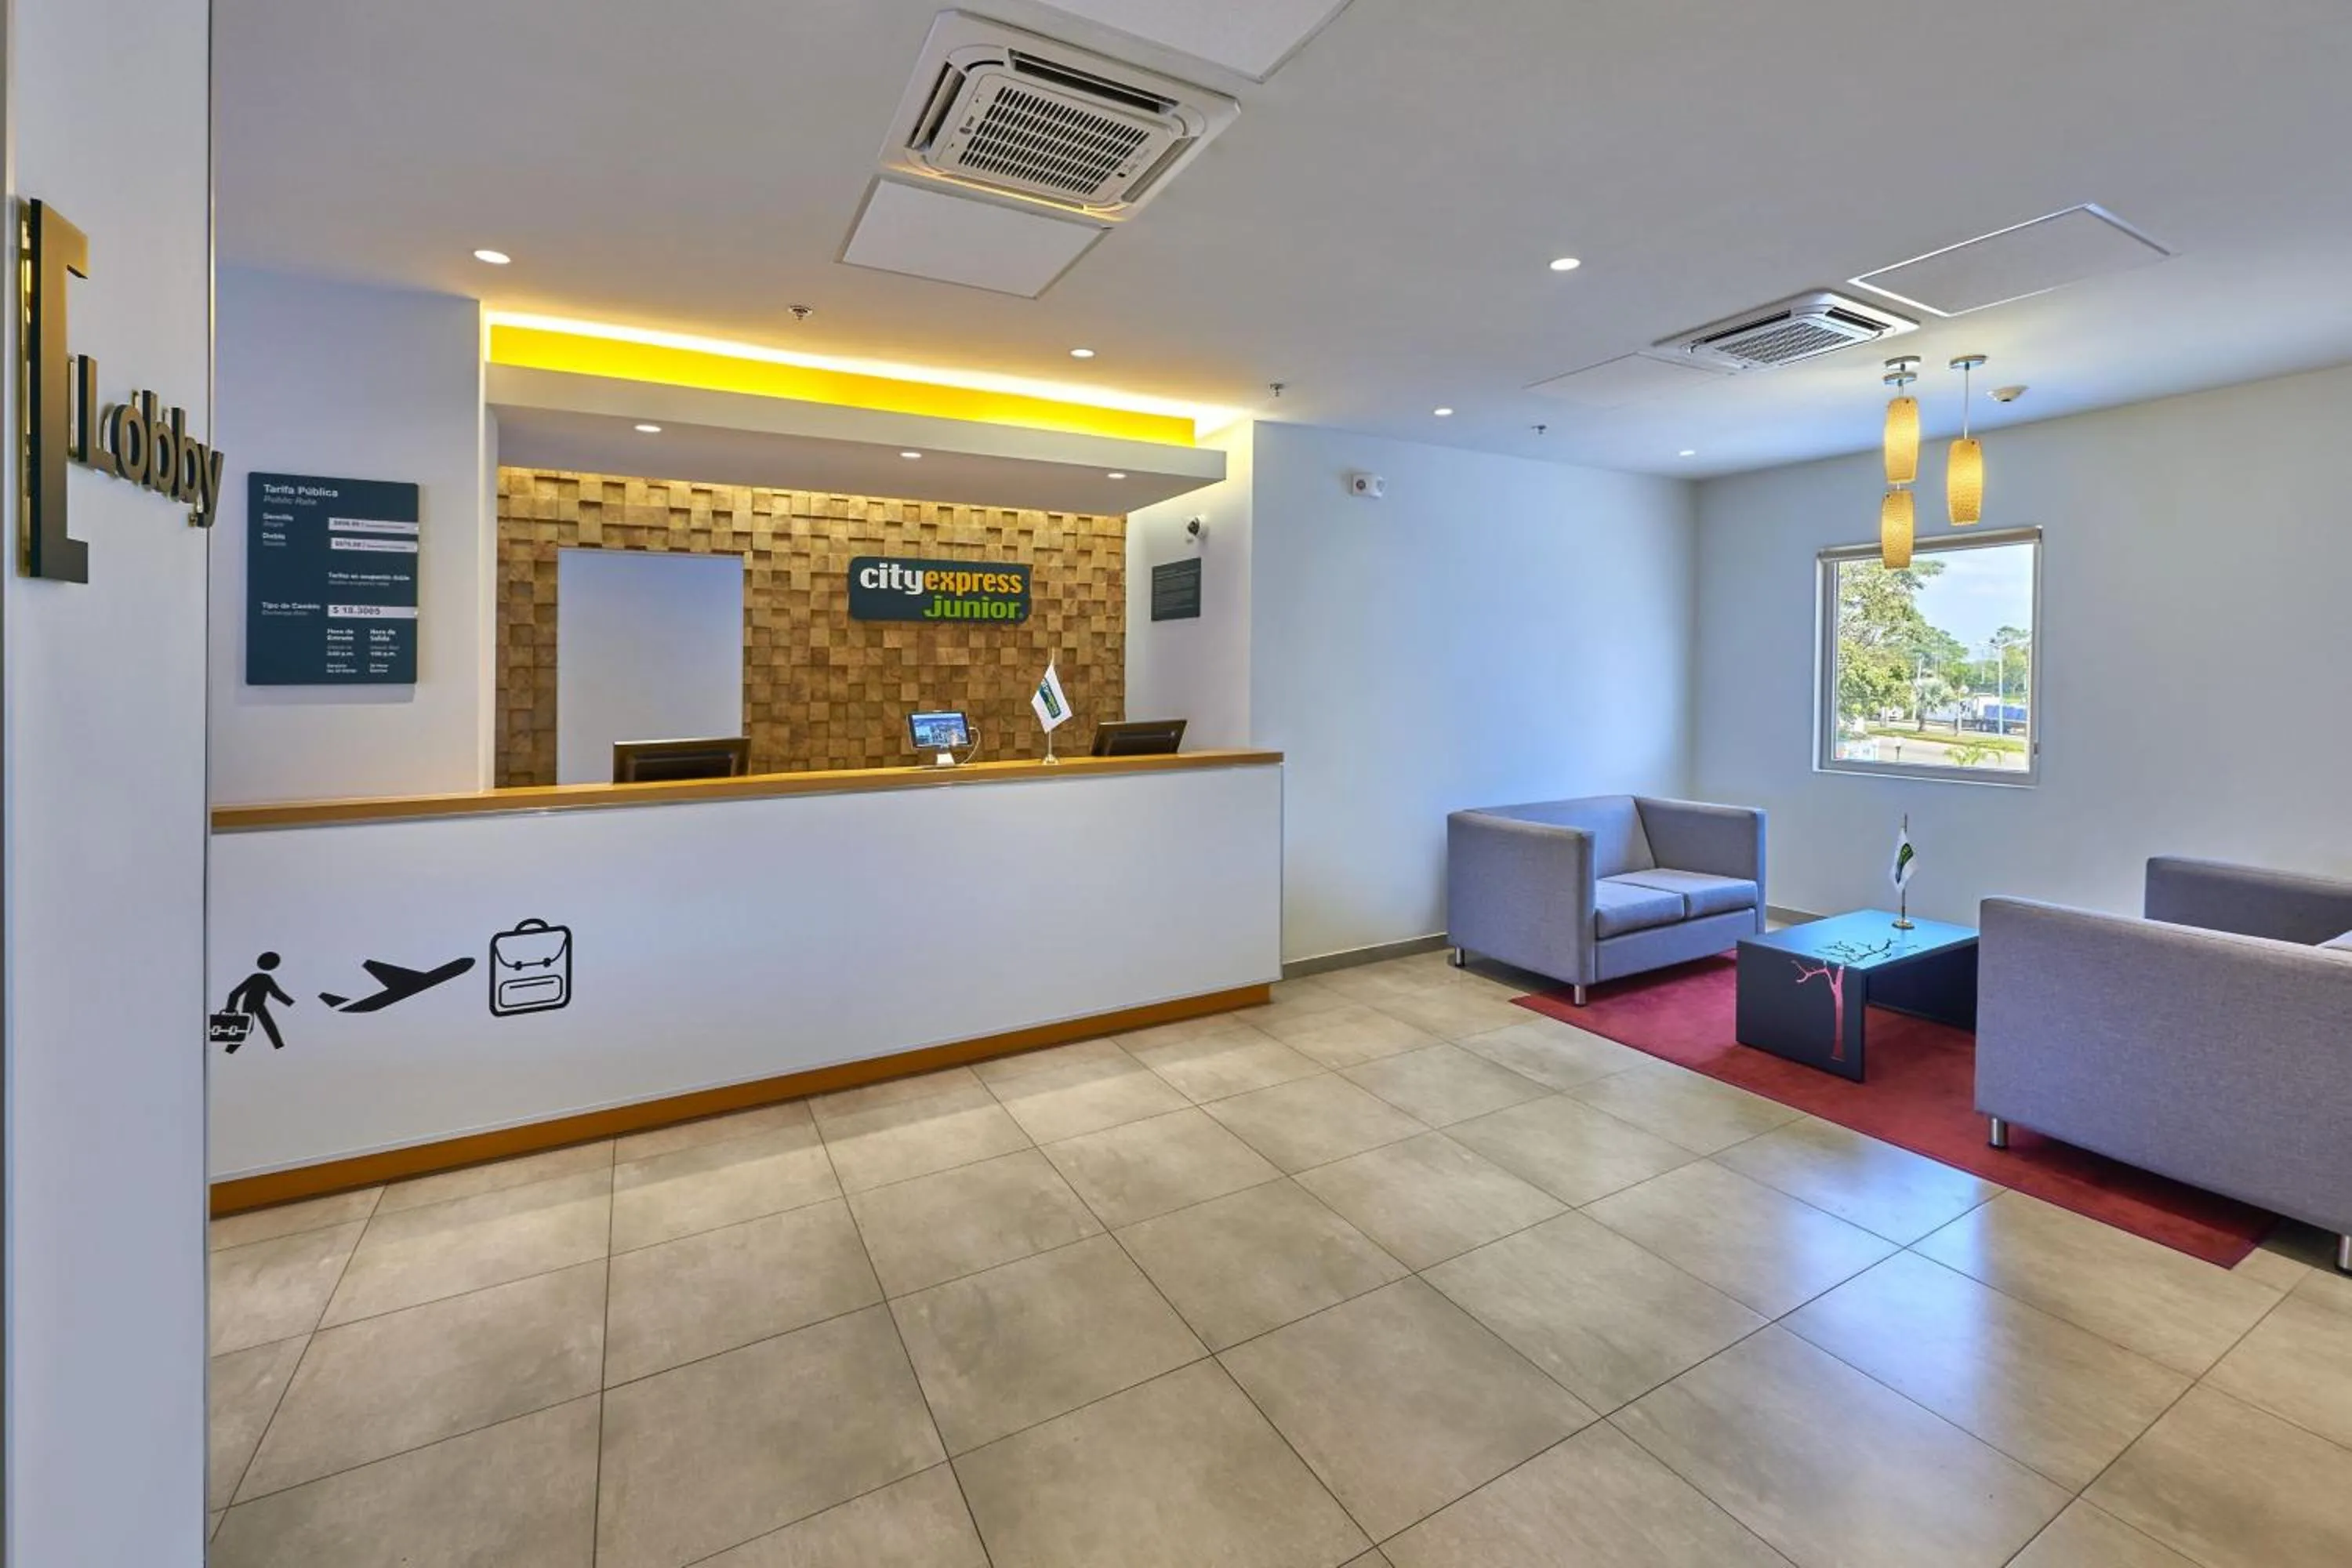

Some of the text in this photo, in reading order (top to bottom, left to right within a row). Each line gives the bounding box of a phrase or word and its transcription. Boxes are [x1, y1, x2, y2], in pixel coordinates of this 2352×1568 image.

[78, 354, 224, 528] Lobby
[263, 484, 339, 498] Tarifa Pública
